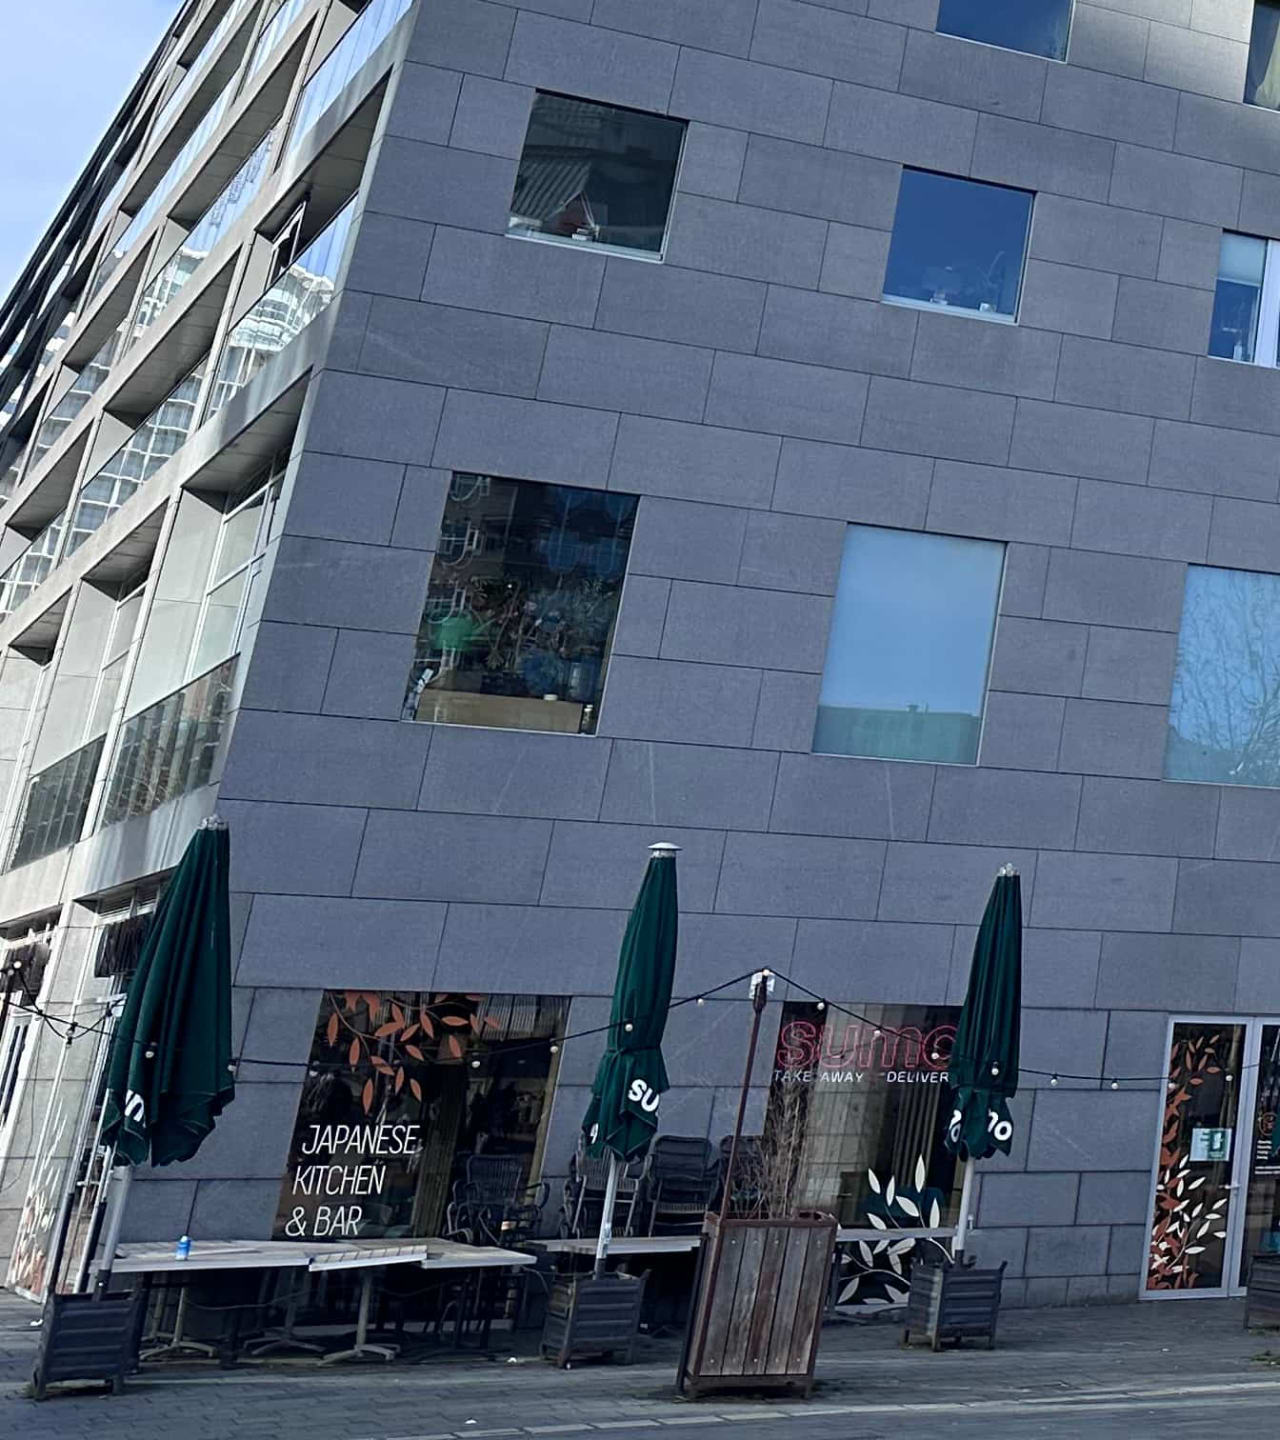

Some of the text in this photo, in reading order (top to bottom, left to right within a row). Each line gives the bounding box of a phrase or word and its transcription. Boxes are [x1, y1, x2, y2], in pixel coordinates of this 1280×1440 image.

[773, 1070, 951, 1083] TAKE AWAY DELIVER
[301, 1124, 421, 1155] JAPANESE
[291, 1165, 387, 1196] KITCHEN
[284, 1205, 363, 1237] & BAR
